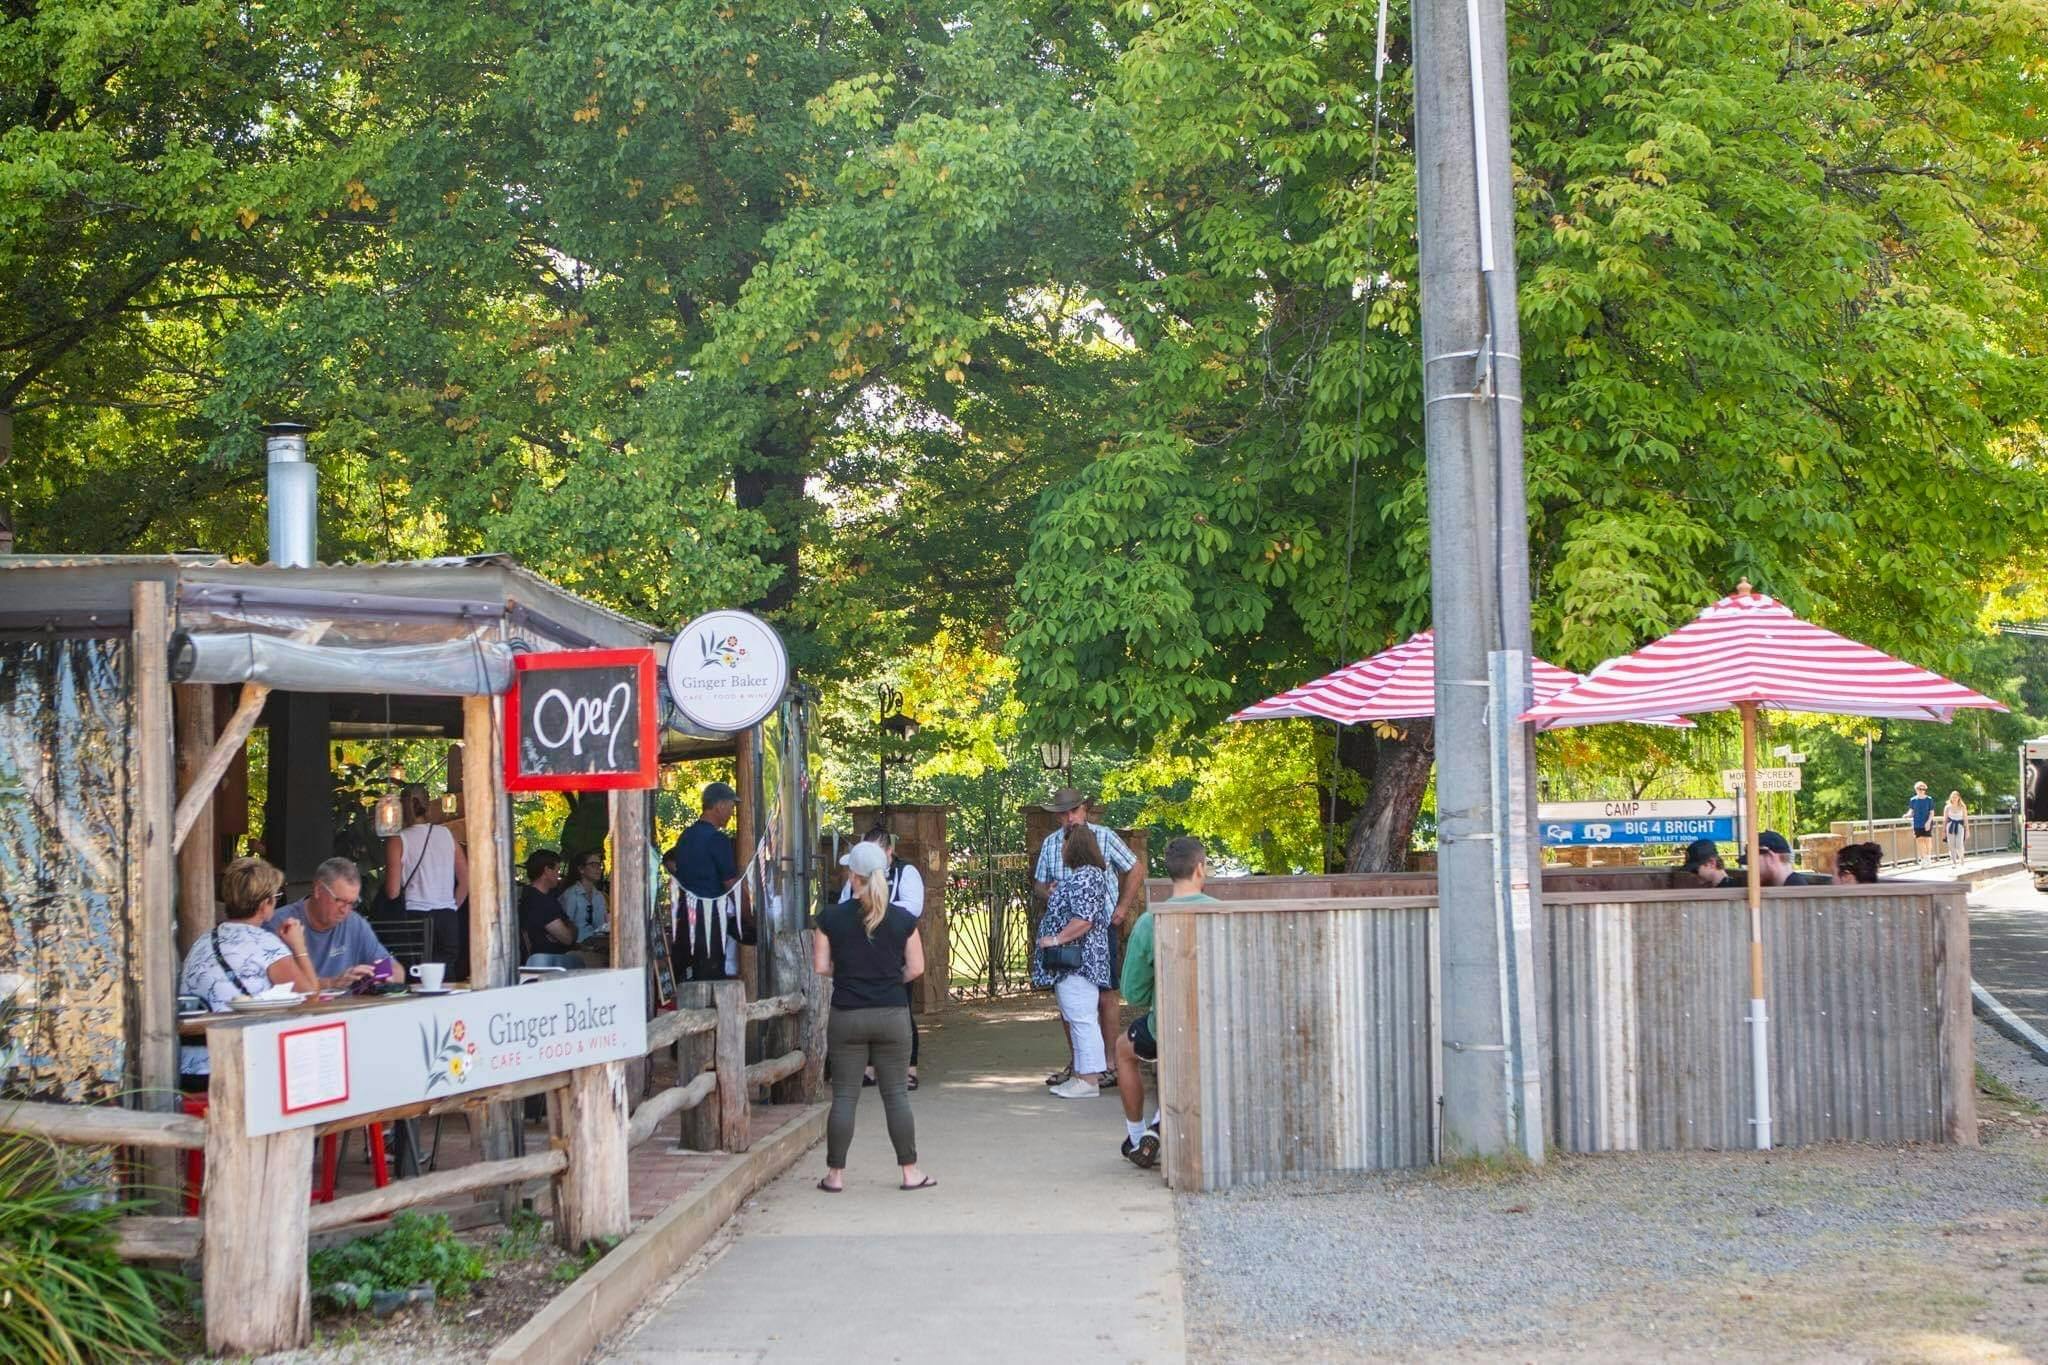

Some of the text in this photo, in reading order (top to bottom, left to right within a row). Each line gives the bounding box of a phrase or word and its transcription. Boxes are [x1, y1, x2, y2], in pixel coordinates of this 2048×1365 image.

[682, 674, 768, 691] Ginger Baker
[533, 682, 631, 768] Open
[1767, 770, 1794, 779] CREEK
[1762, 780, 1793, 789] BRIDGE
[1605, 802, 1640, 817] CAMP
[1625, 820, 1715, 835] BIG 4 BRIGHT
[1644, 835, 1662, 843] TURN
[488, 997, 617, 1048] Ginger Baker
[490, 1051, 521, 1070] CAFE
[539, 1041, 573, 1060] FOOD
[577, 1040, 585, 1053] &
[589, 1033, 618, 1050] WINE
